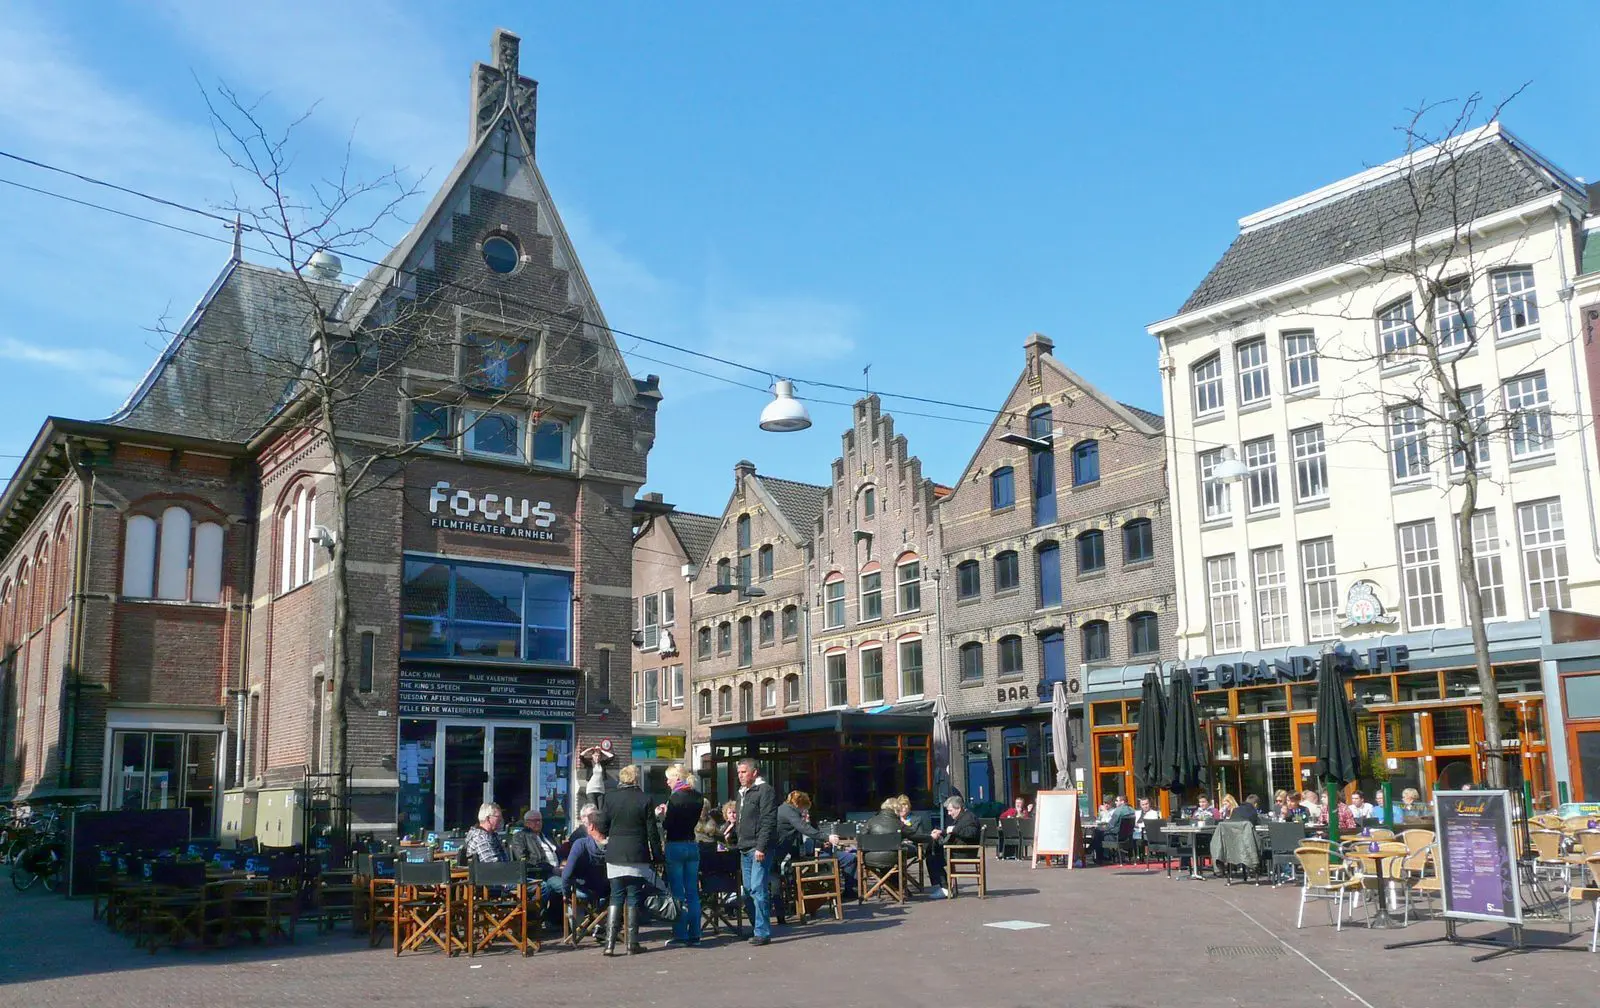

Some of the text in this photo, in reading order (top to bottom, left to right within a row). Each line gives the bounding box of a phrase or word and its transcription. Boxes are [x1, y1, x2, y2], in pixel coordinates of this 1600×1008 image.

[429, 480, 557, 528] FOCUS
[431, 517, 554, 541] FILMTHEATER ARNHEM
[400, 670, 441, 679] BLACK SWAN
[1214, 655, 1317, 687] GRAND
[486, 675, 518, 683] VALENTINE
[436, 683, 461, 692] SPEECH
[547, 688, 561, 696] TRUE
[430, 694, 451, 702] AFTER
[451, 695, 486, 704] CHRISTMAS
[997, 685, 1029, 702] BAR
[1454, 800, 1485, 813] Lunch
